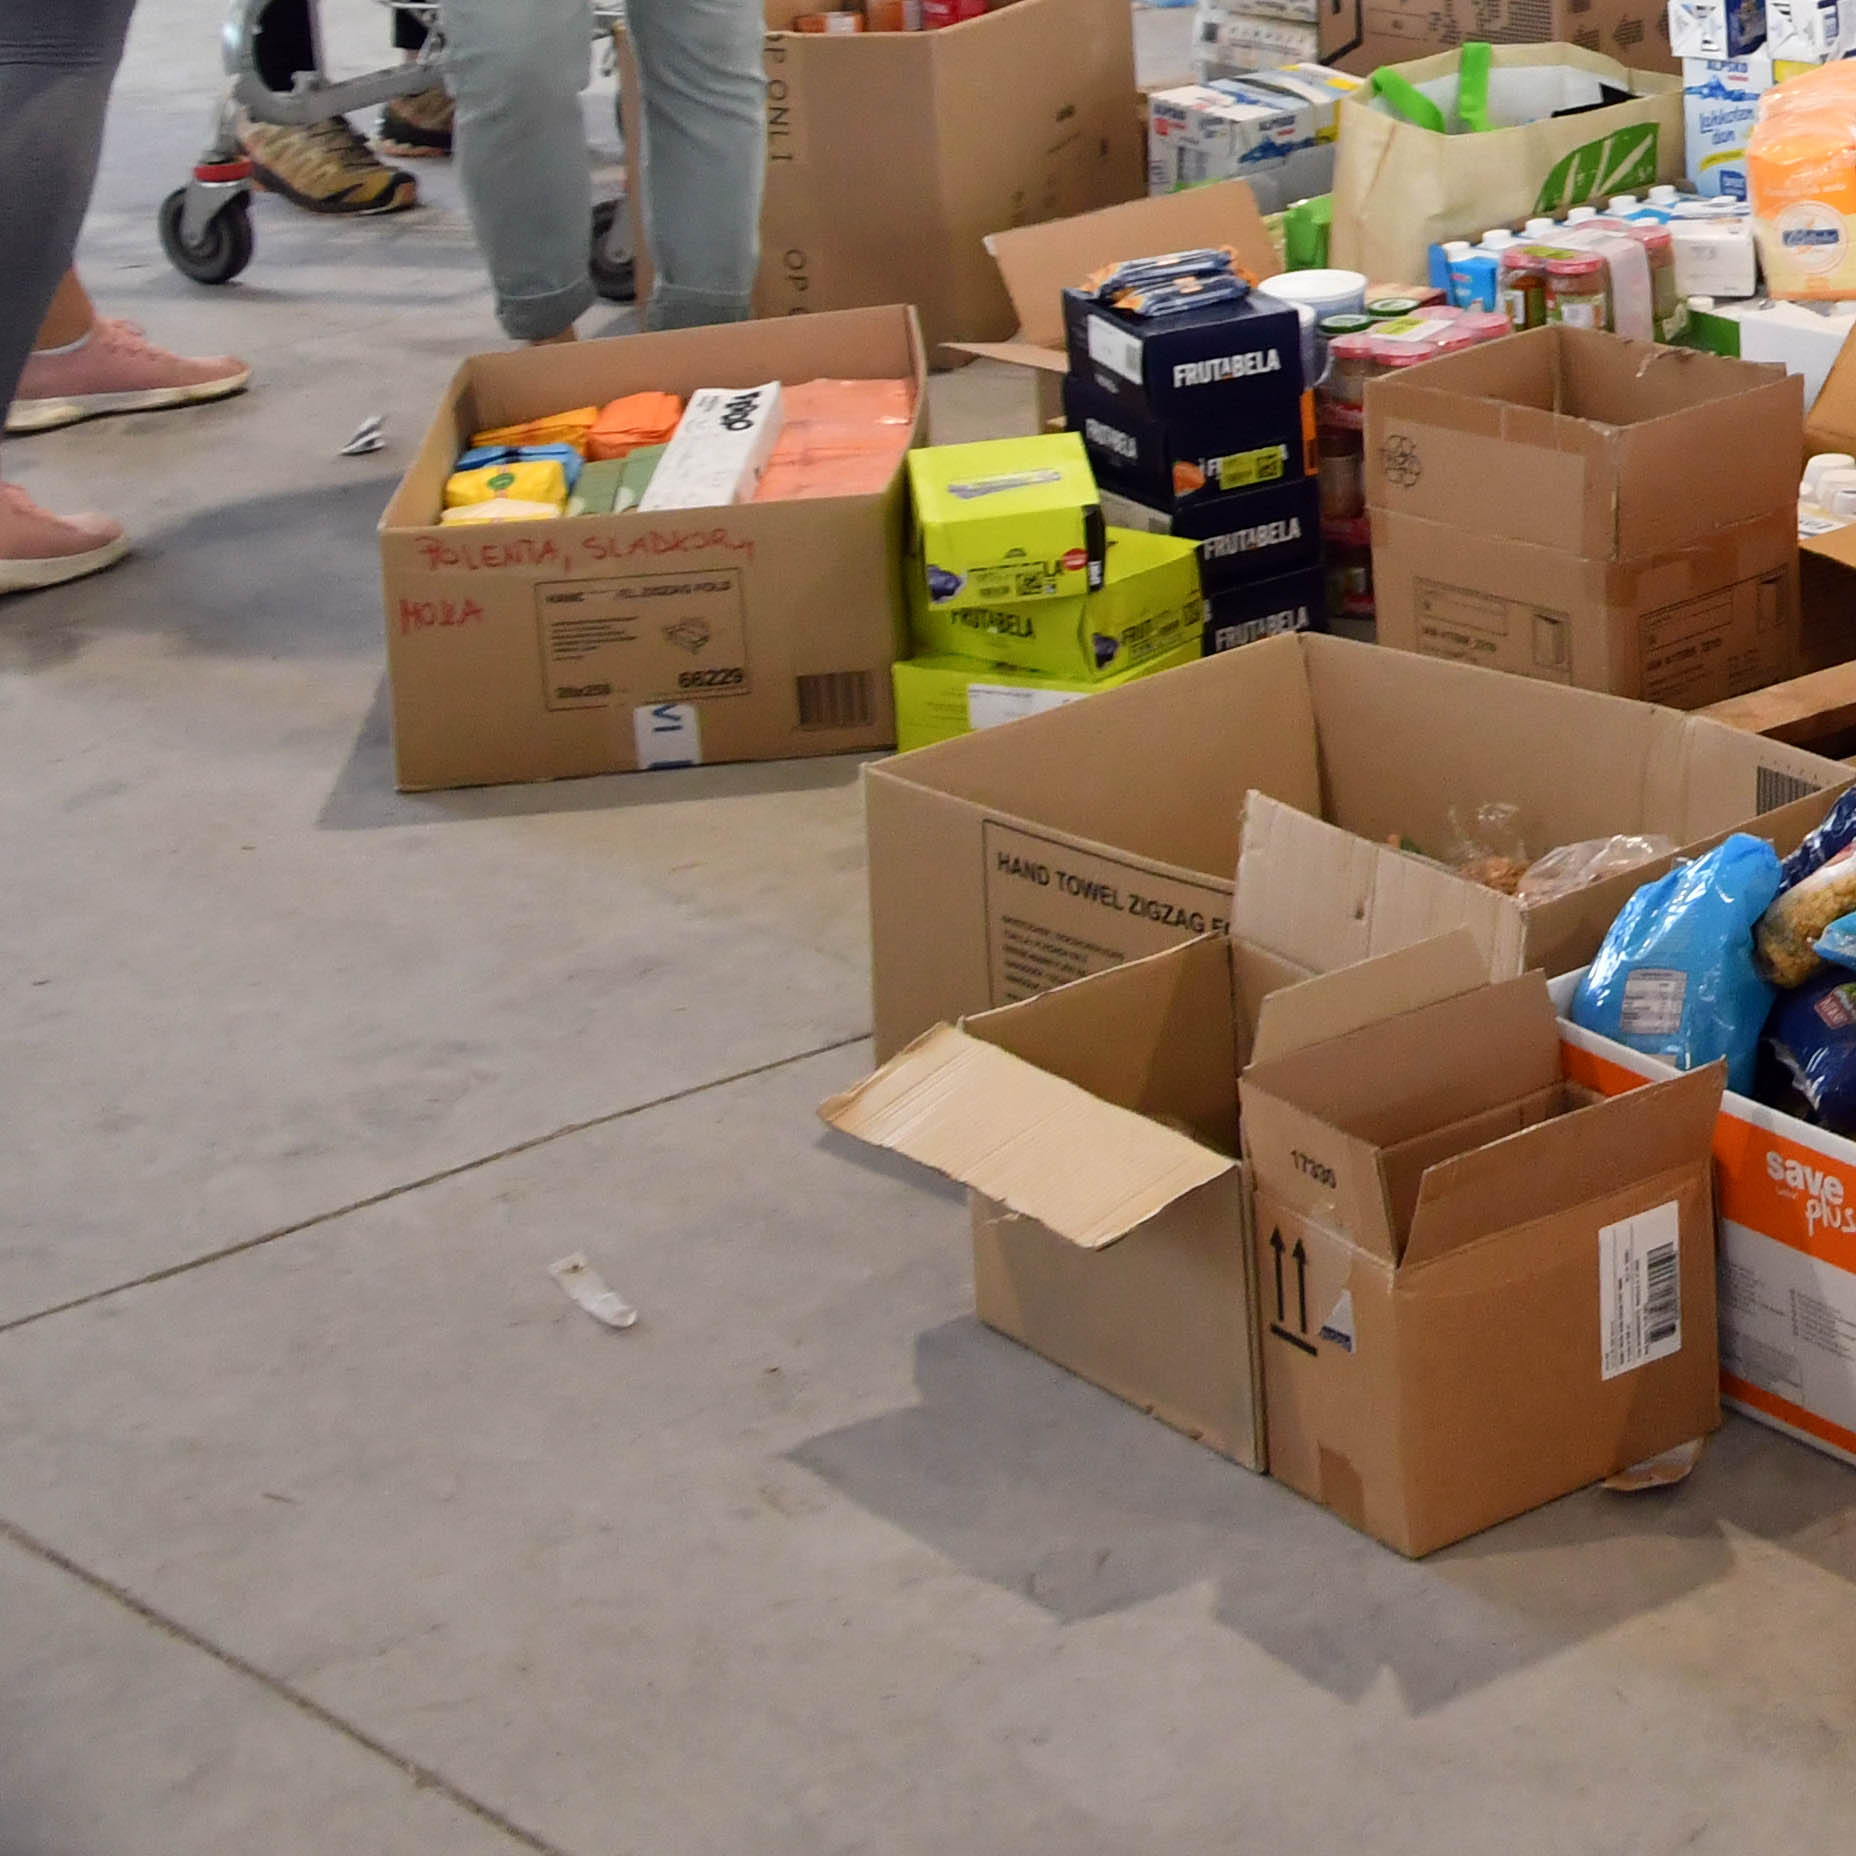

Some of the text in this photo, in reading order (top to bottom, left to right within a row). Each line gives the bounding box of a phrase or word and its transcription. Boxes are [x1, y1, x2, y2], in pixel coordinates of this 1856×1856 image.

[996, 850, 1208, 932] HAND TOWEL ZIGZAG
[1765, 1150, 1844, 1205] save
[1805, 1188, 1856, 1237] plus
